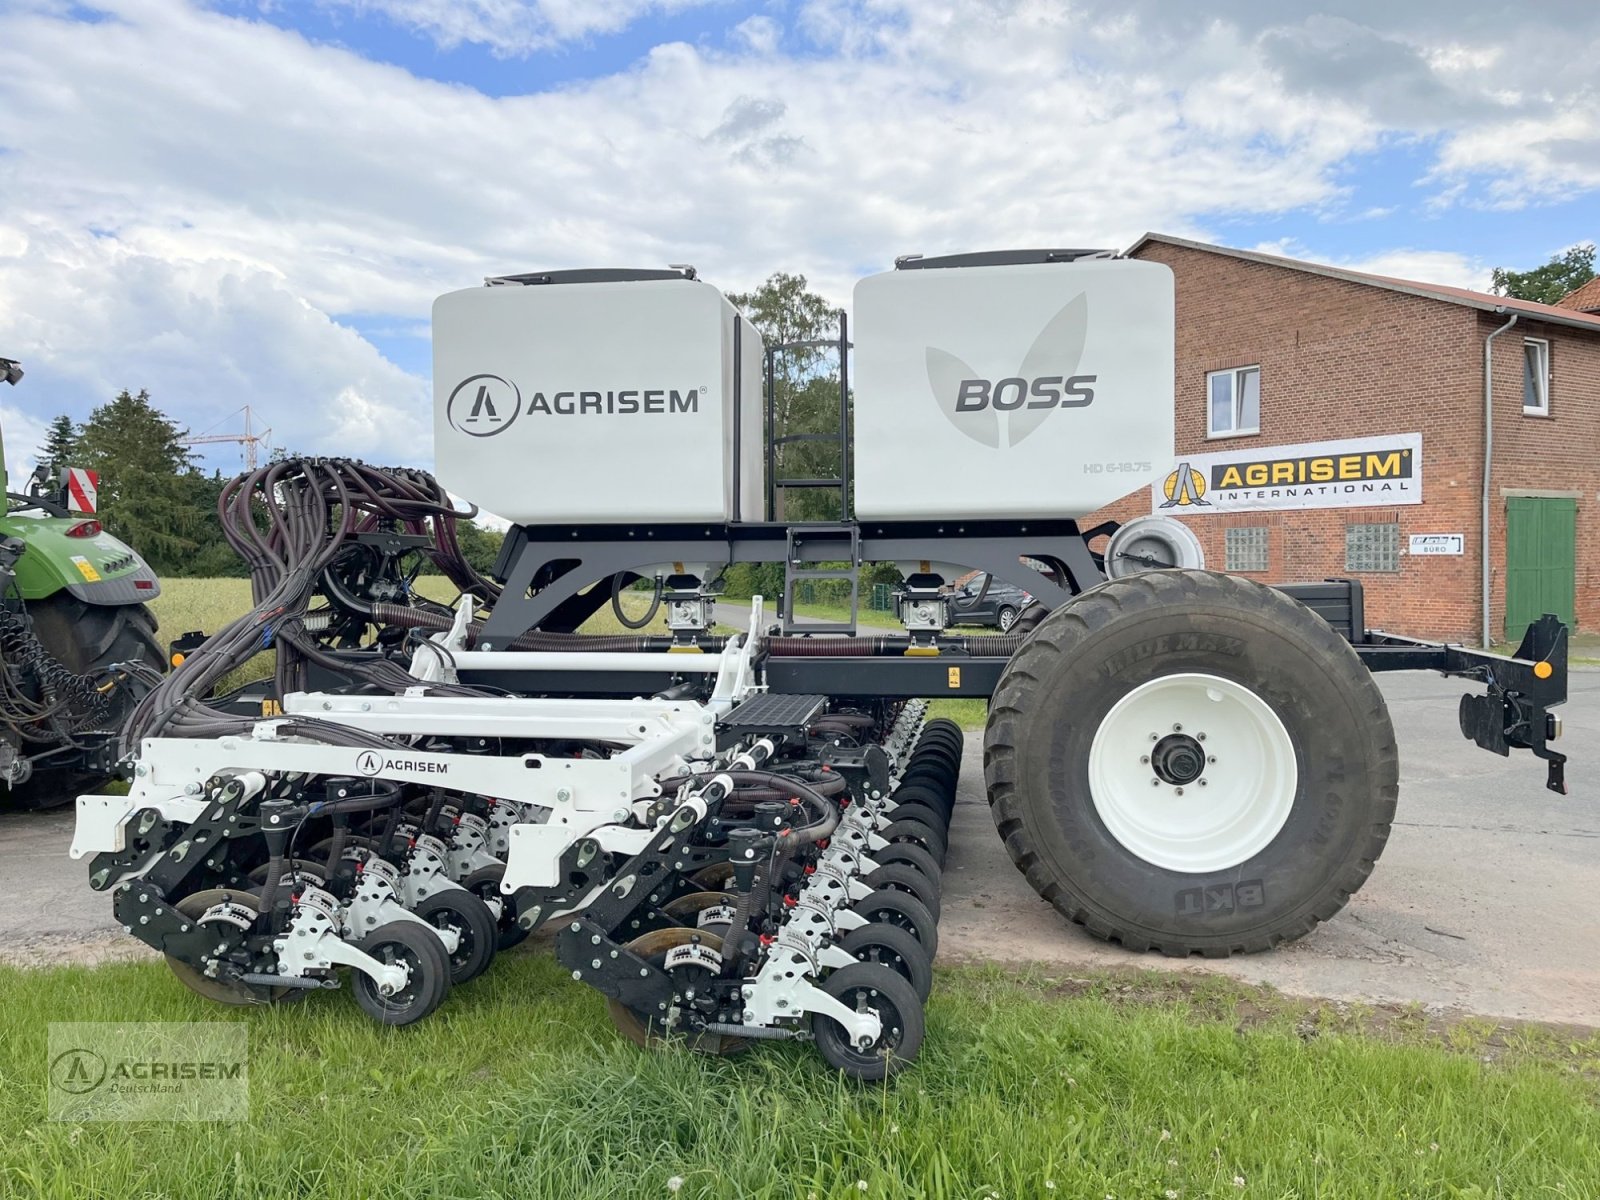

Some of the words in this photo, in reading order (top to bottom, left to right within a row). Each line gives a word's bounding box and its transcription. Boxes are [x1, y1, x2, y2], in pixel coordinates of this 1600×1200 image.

[526, 389, 699, 416] AGRISEM
[955, 375, 1097, 412] BOSS
[1083, 463, 1103, 474] HD
[1219, 452, 1401, 488] AGRISEM
[1218, 482, 1410, 501] INTERNATIONAL
[385, 759, 448, 774] AGRISEM
[1177, 882, 1264, 915] BKT
